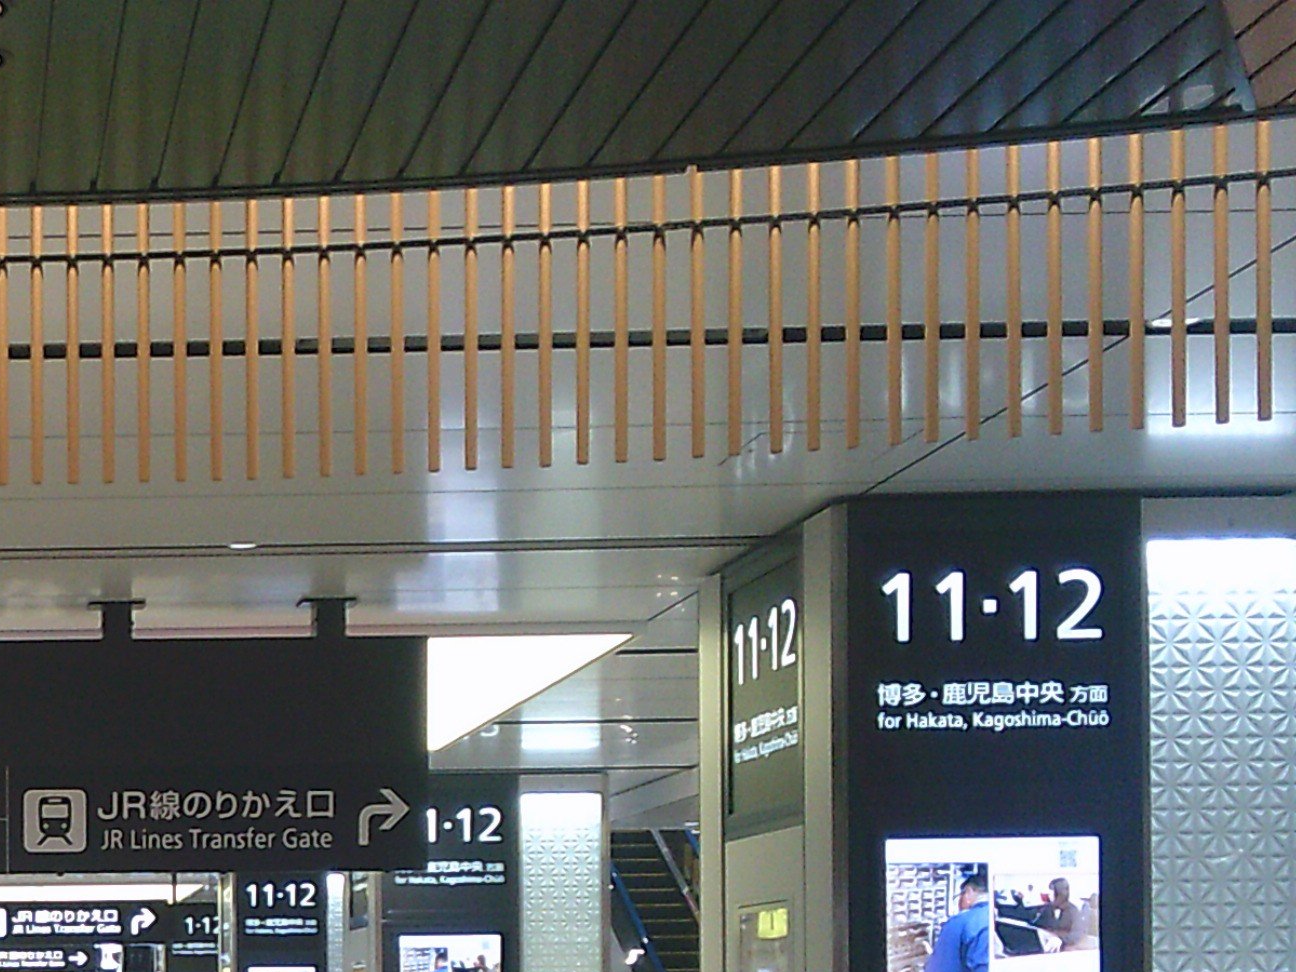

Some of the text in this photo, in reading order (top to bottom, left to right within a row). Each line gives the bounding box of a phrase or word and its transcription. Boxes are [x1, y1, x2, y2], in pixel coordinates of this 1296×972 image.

[1069, 684, 1109, 705] 方面
[877, 709, 902, 729] for
[905, 711, 968, 732] Hakata,
[96, 789, 336, 820] JR線のりかえ口
[425, 806, 503, 843] 1·12
[100, 827, 333, 851] JR Lines Transfer Gate
